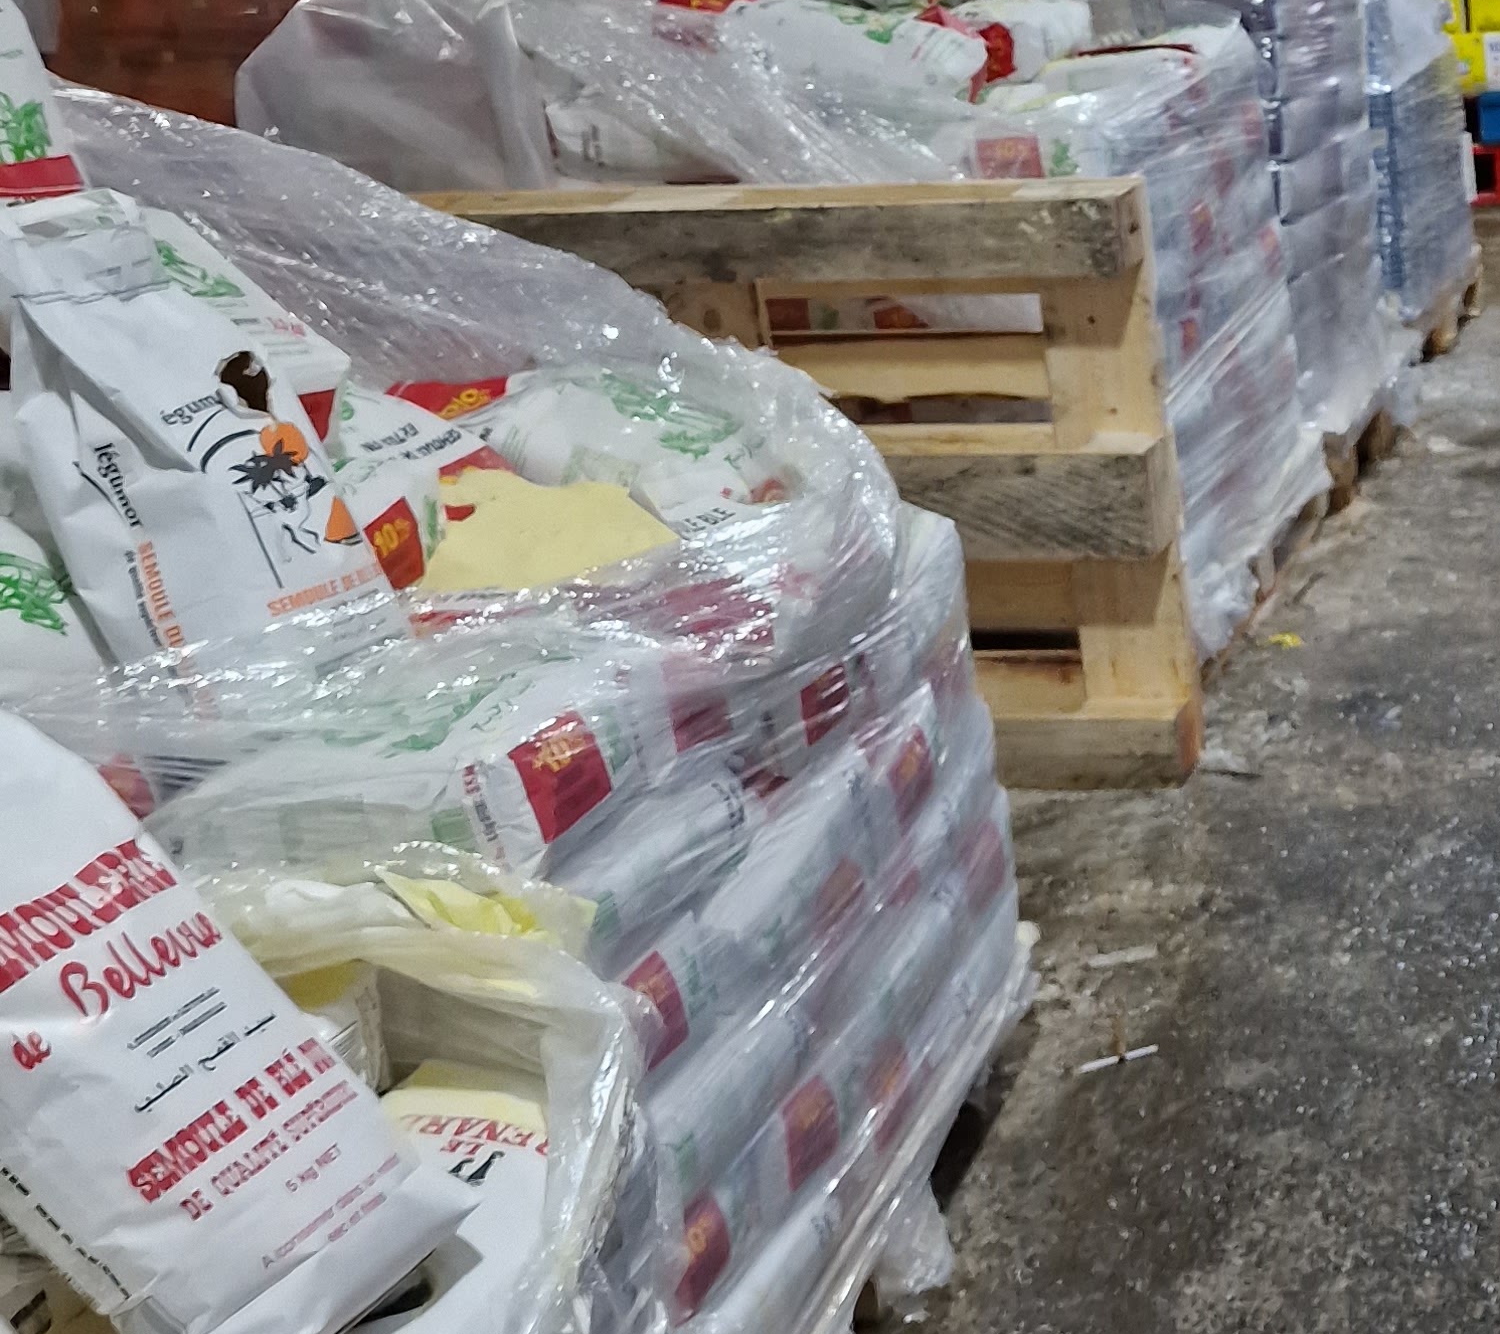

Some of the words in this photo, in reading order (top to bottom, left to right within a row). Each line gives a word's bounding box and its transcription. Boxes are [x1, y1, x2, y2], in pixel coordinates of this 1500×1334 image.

[94, 442, 144, 528] légumor
[57, 910, 223, 1019] Bellevue
[12, 1030, 51, 1071] de
[126, 1098, 249, 1204] SEMOULE
[234, 1076, 280, 1120] DE
[179, 1188, 214, 1222] DE
[210, 1128, 290, 1197] QUALITÉ
